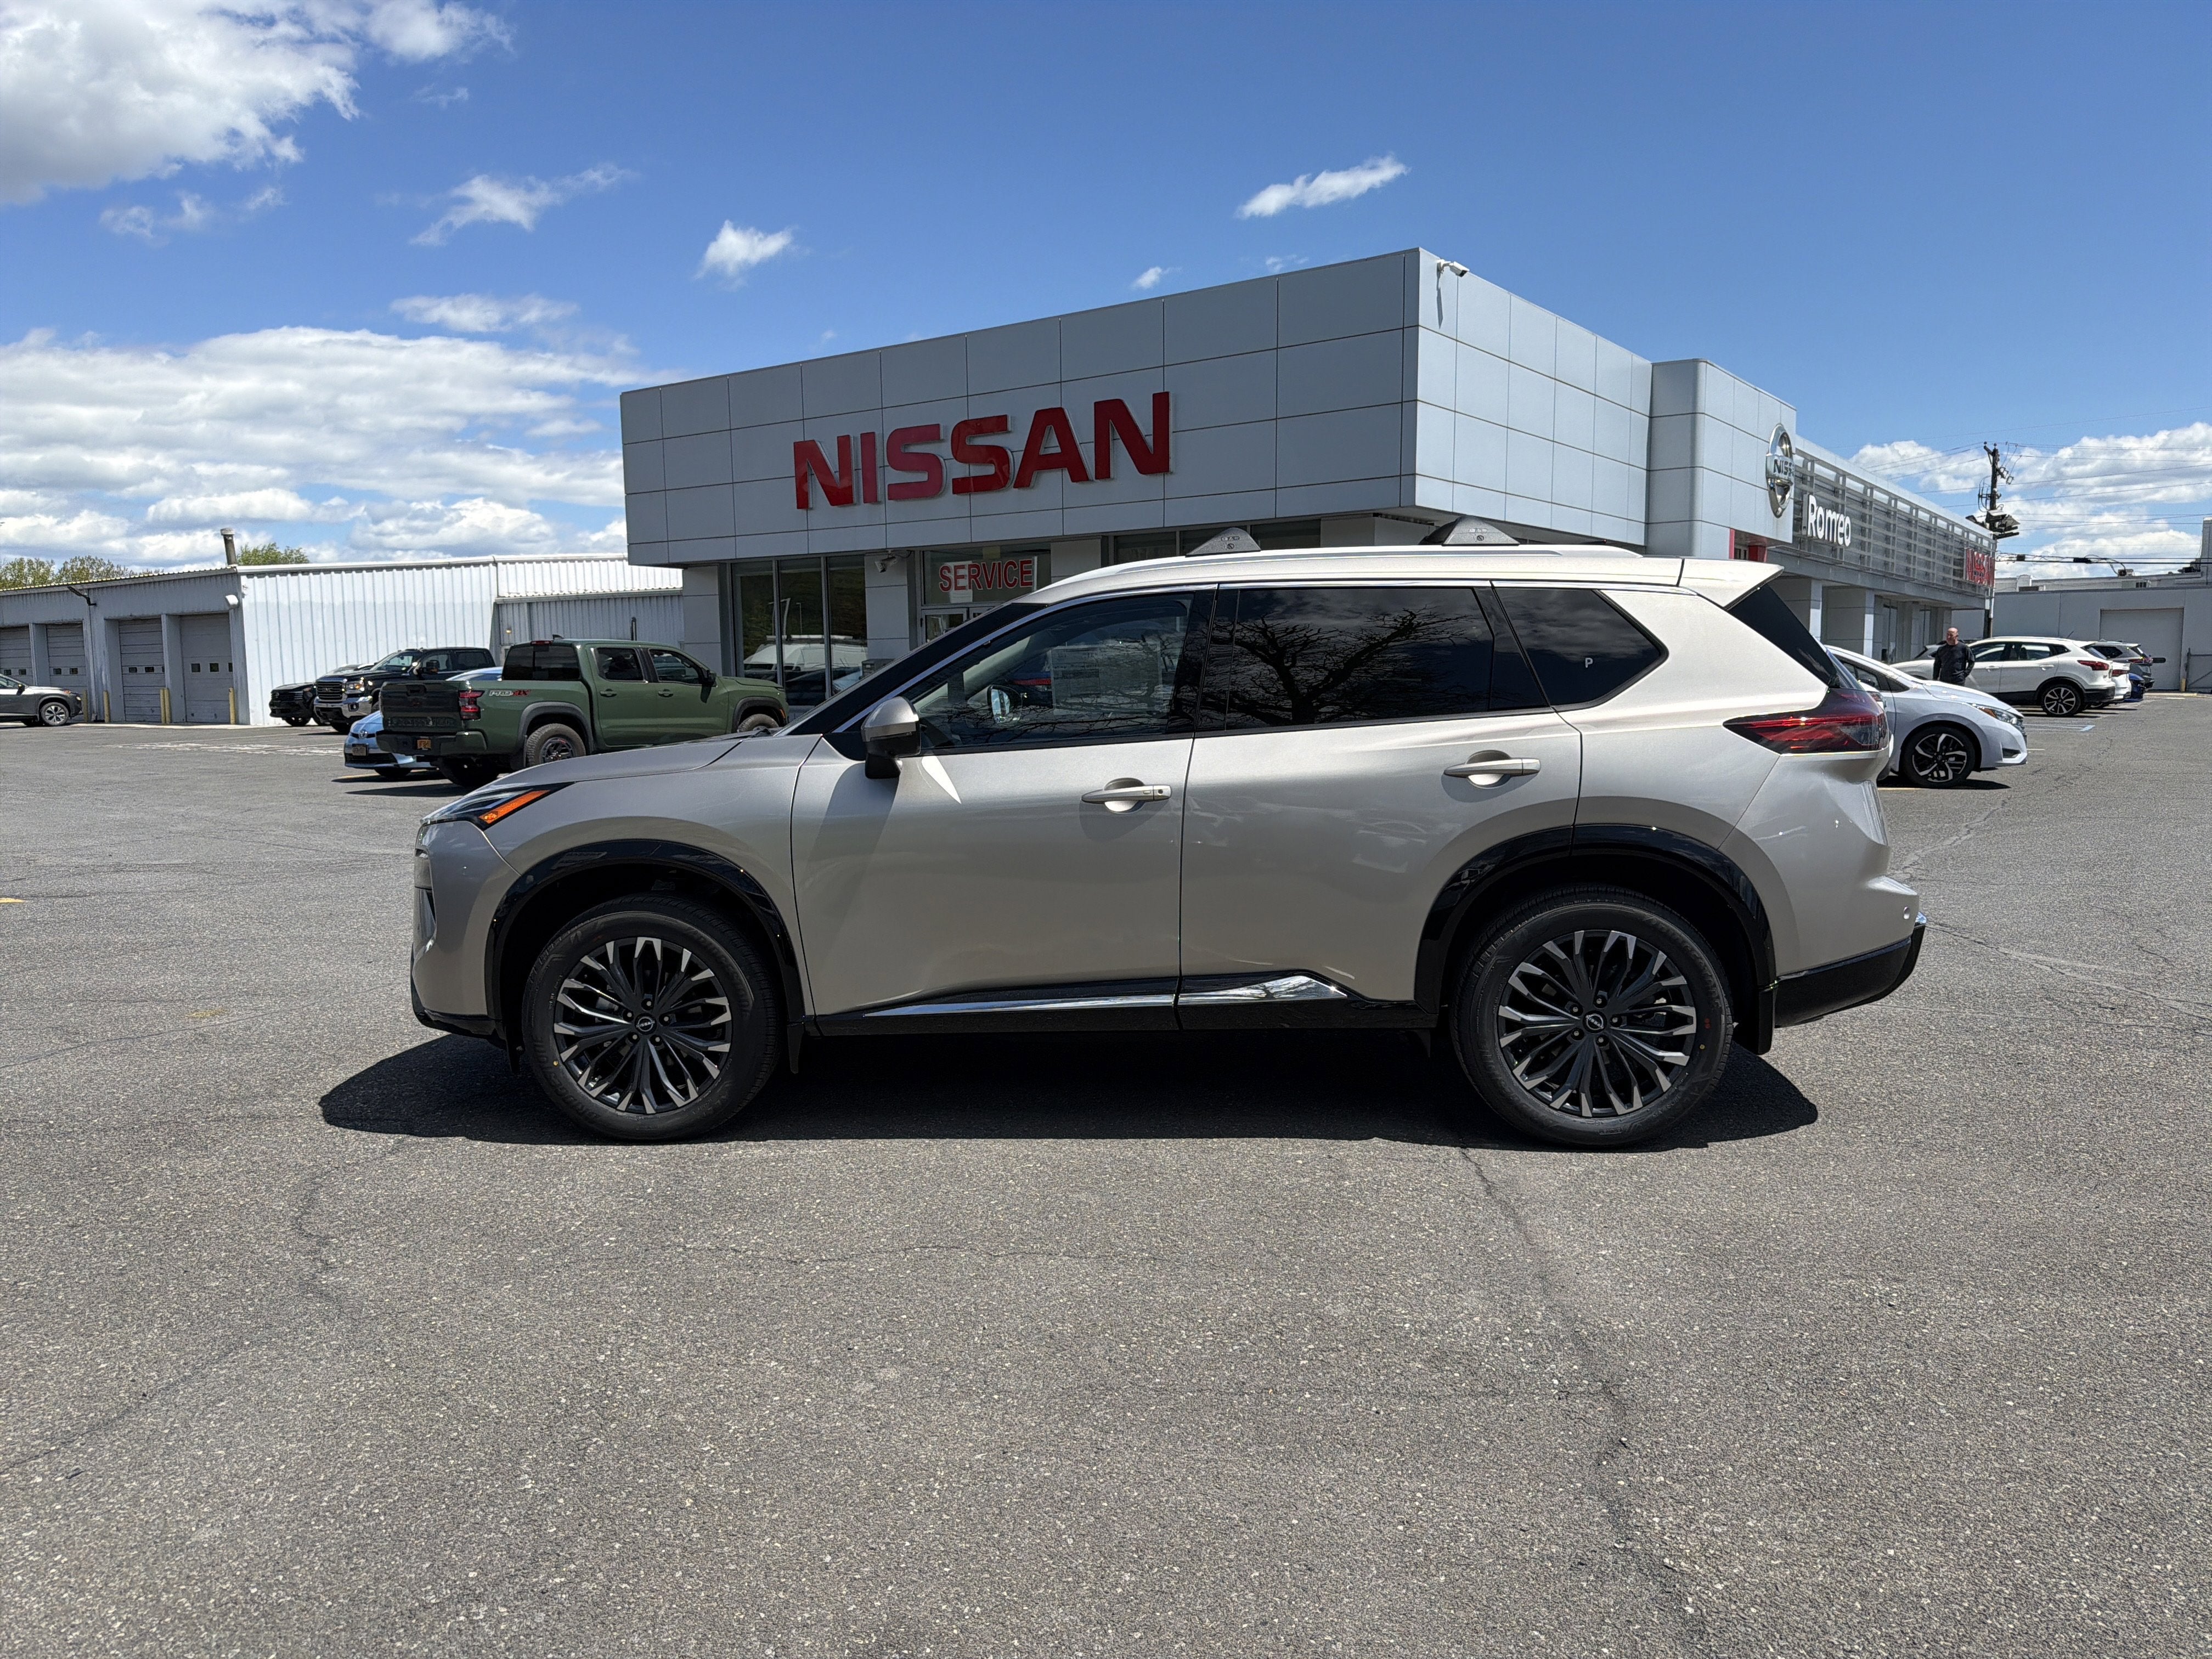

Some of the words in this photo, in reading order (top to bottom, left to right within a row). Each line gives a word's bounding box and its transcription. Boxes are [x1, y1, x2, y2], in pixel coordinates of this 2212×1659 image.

[793, 391, 1170, 510] NISSAN
[1807, 494, 1851, 547] Romeo
[939, 558, 1033, 593] SERVICE
